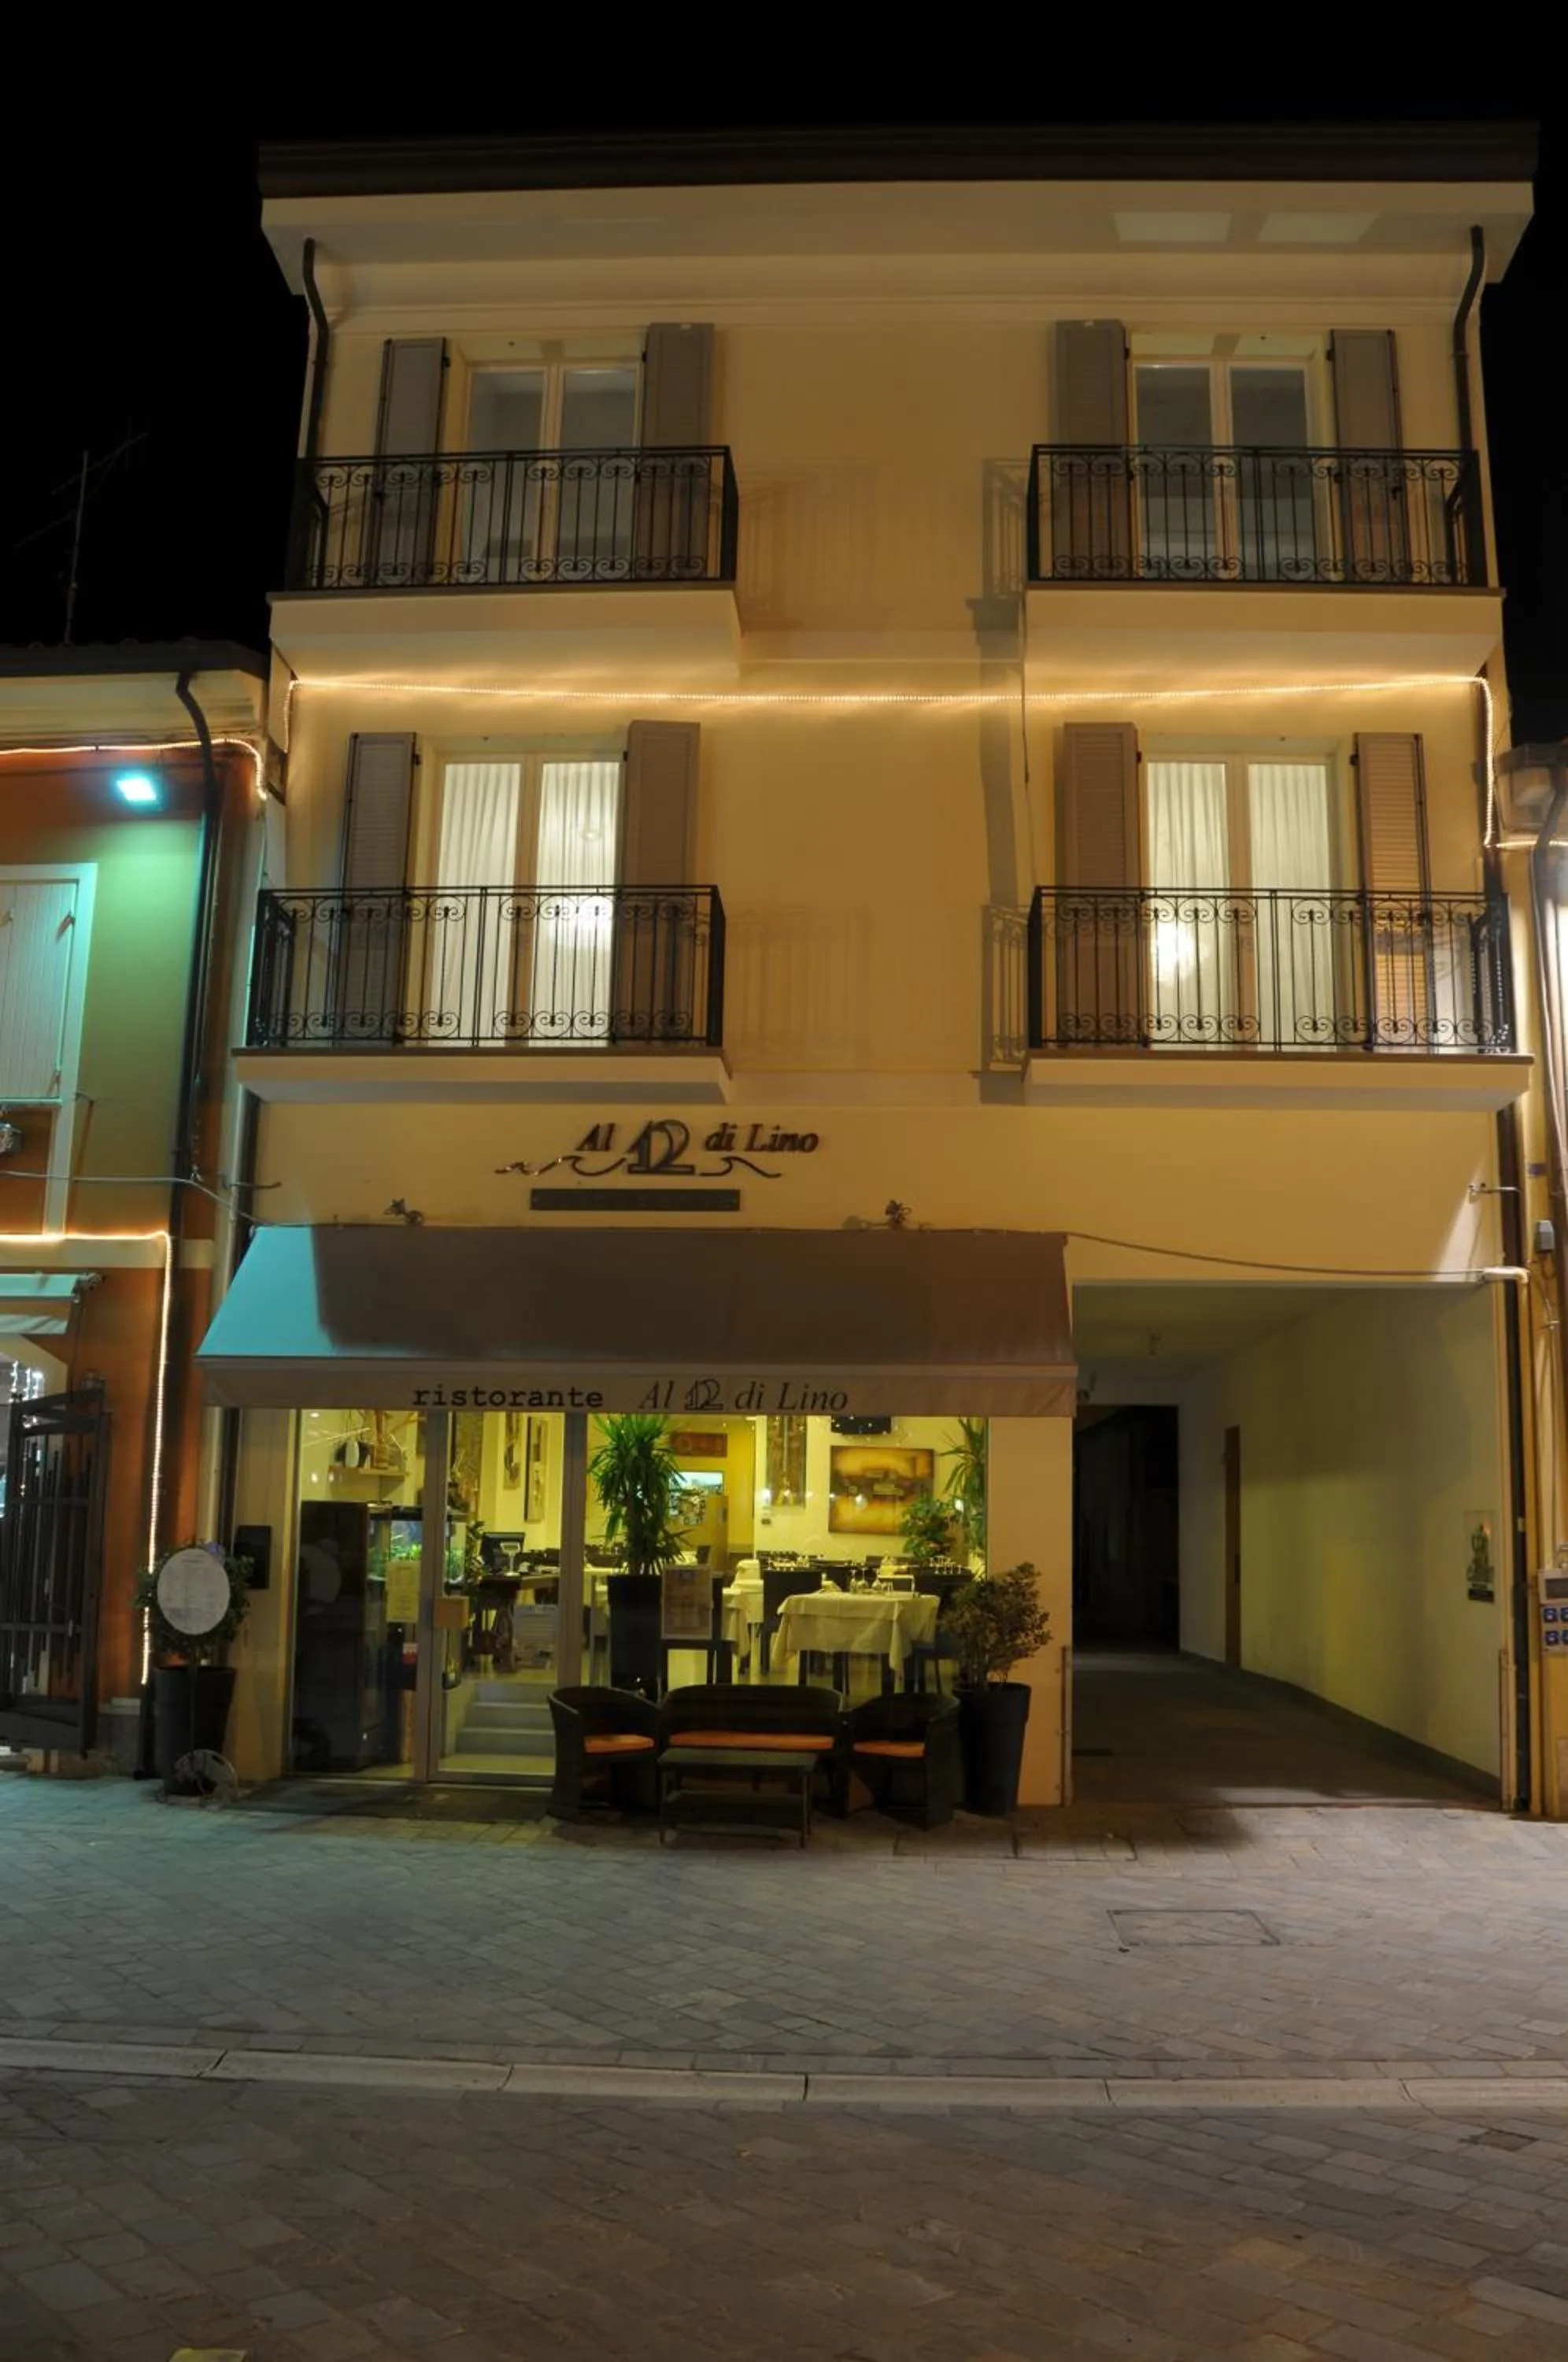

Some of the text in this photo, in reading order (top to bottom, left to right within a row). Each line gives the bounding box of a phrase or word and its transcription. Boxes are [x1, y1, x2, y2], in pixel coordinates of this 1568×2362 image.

[575, 1119, 820, 1176] Al 12 di Lino
[412, 1385, 605, 1408] ristorante
[637, 1378, 848, 1411] Al 12 di Lino
